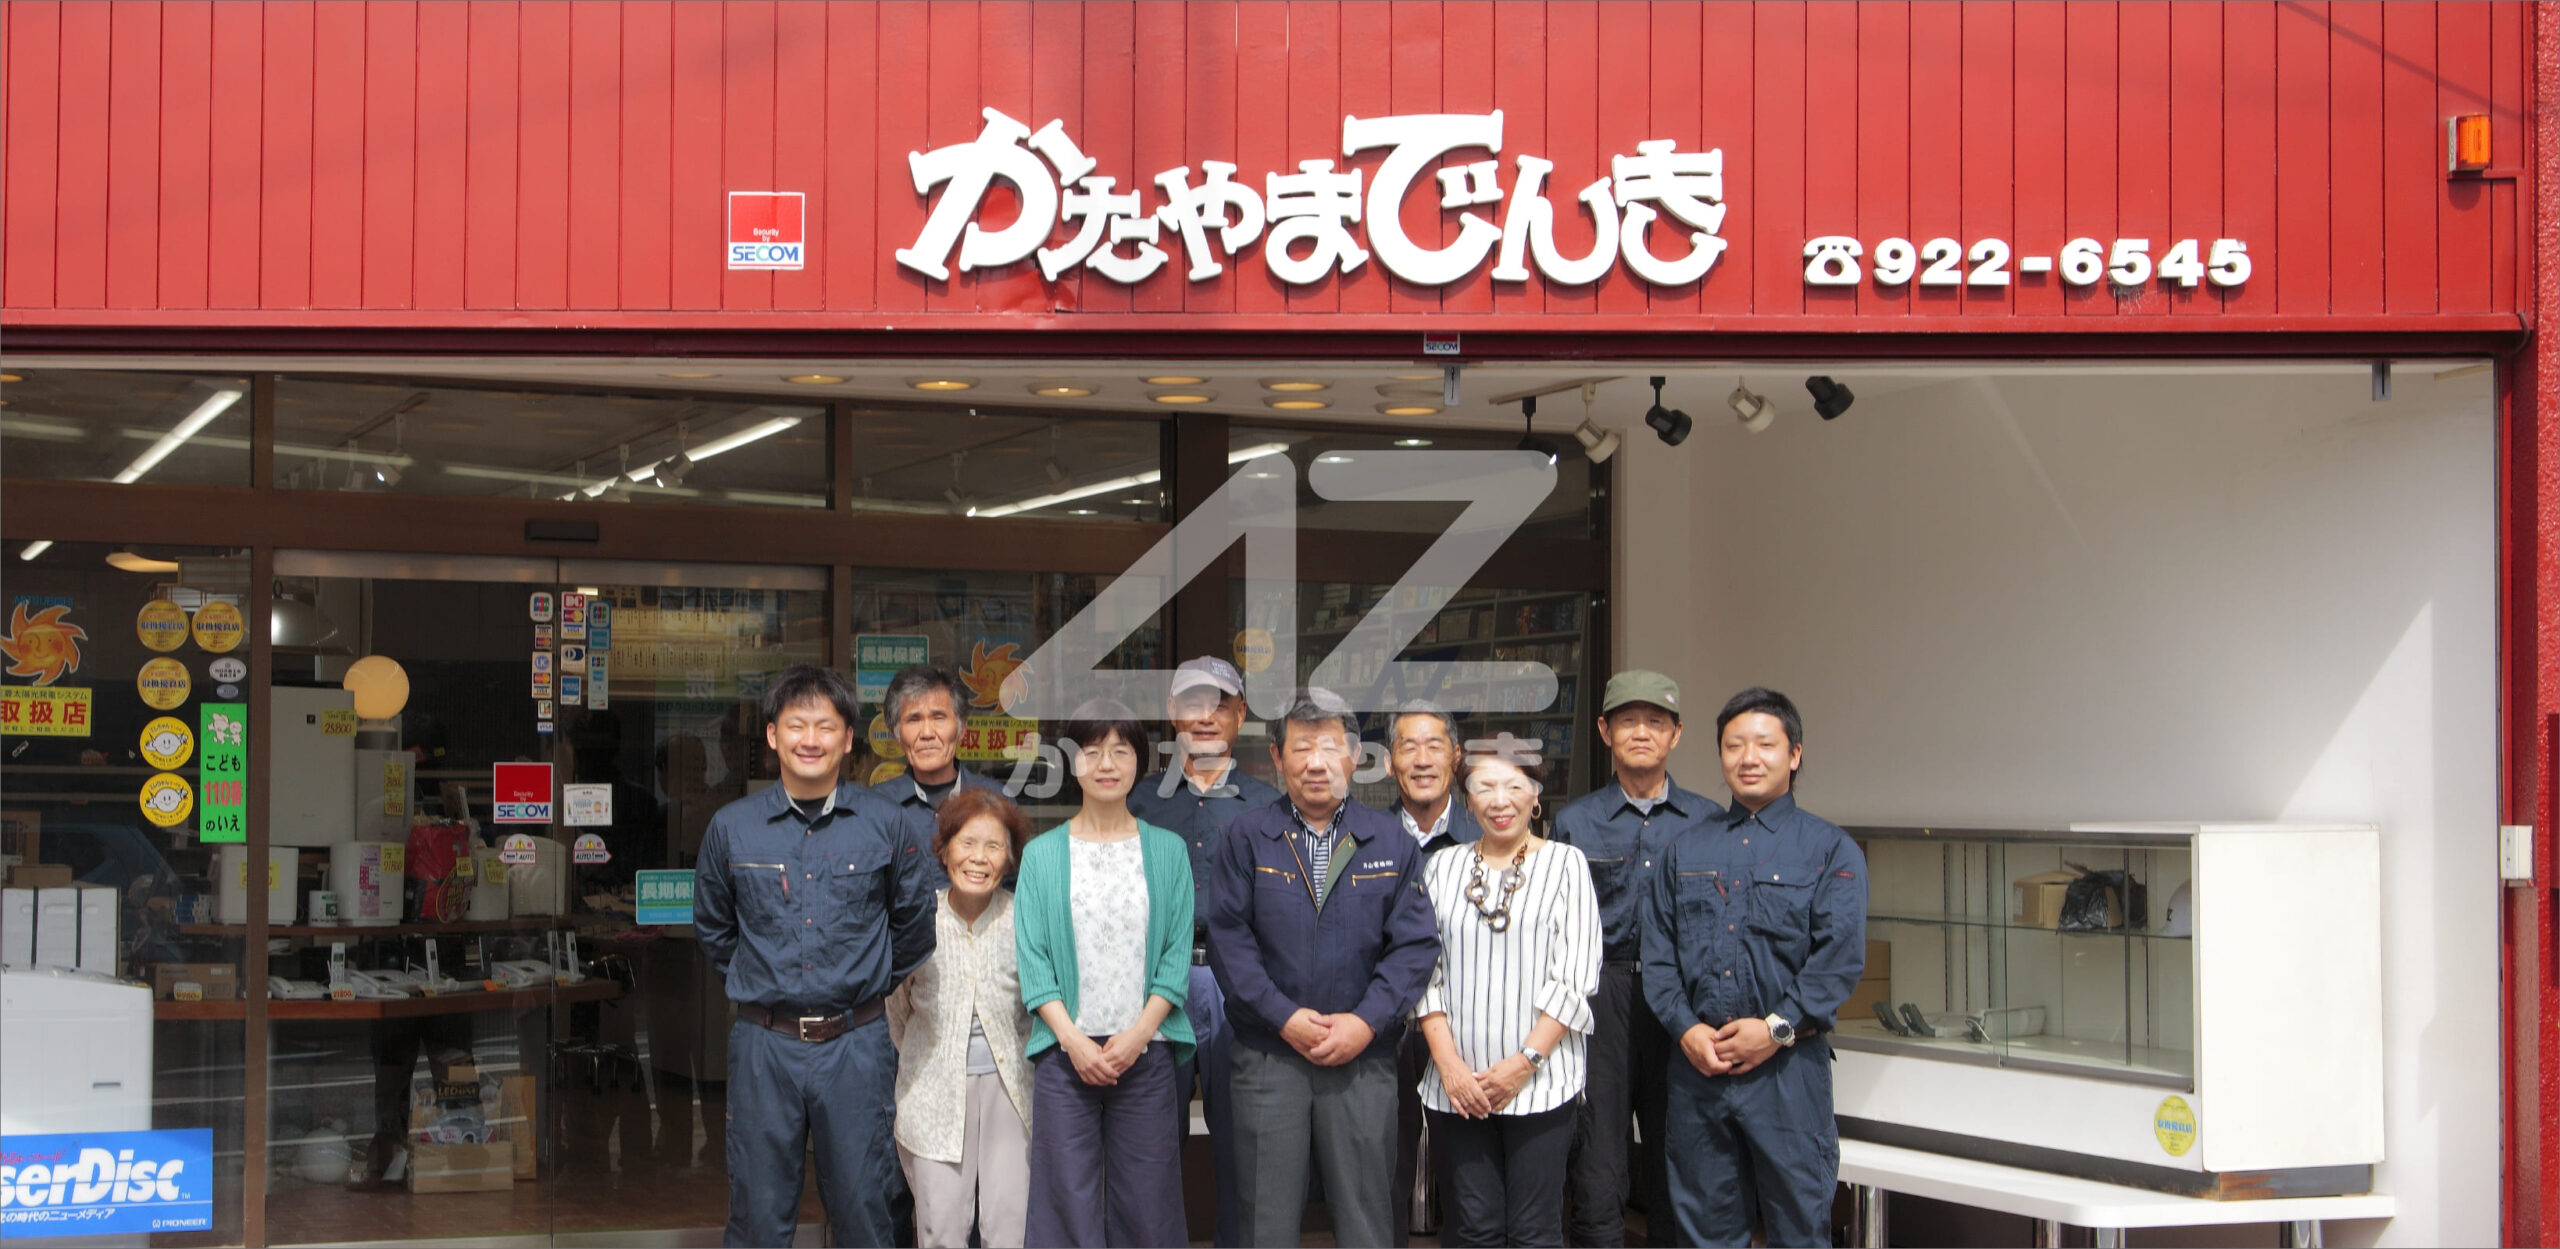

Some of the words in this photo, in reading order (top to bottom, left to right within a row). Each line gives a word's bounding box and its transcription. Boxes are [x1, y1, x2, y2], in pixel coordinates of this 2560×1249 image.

[896, 107, 1728, 286] かたやまでんき
[753, 227, 779, 237] Security
[733, 245, 799, 262] SECOM
[1873, 237, 2252, 287] 922-6545
[1426, 342, 1458, 351] SECOM
[1, 700, 87, 725] 取扱店
[205, 754, 241, 772] こども
[204, 780, 243, 807] 110番
[513, 790, 534, 799] Security
[497, 804, 549, 818] SECOM
[205, 813, 241, 831] のいえ
[641, 882, 694, 899] 長期保
[162, 1217, 208, 1227] PIONEER
